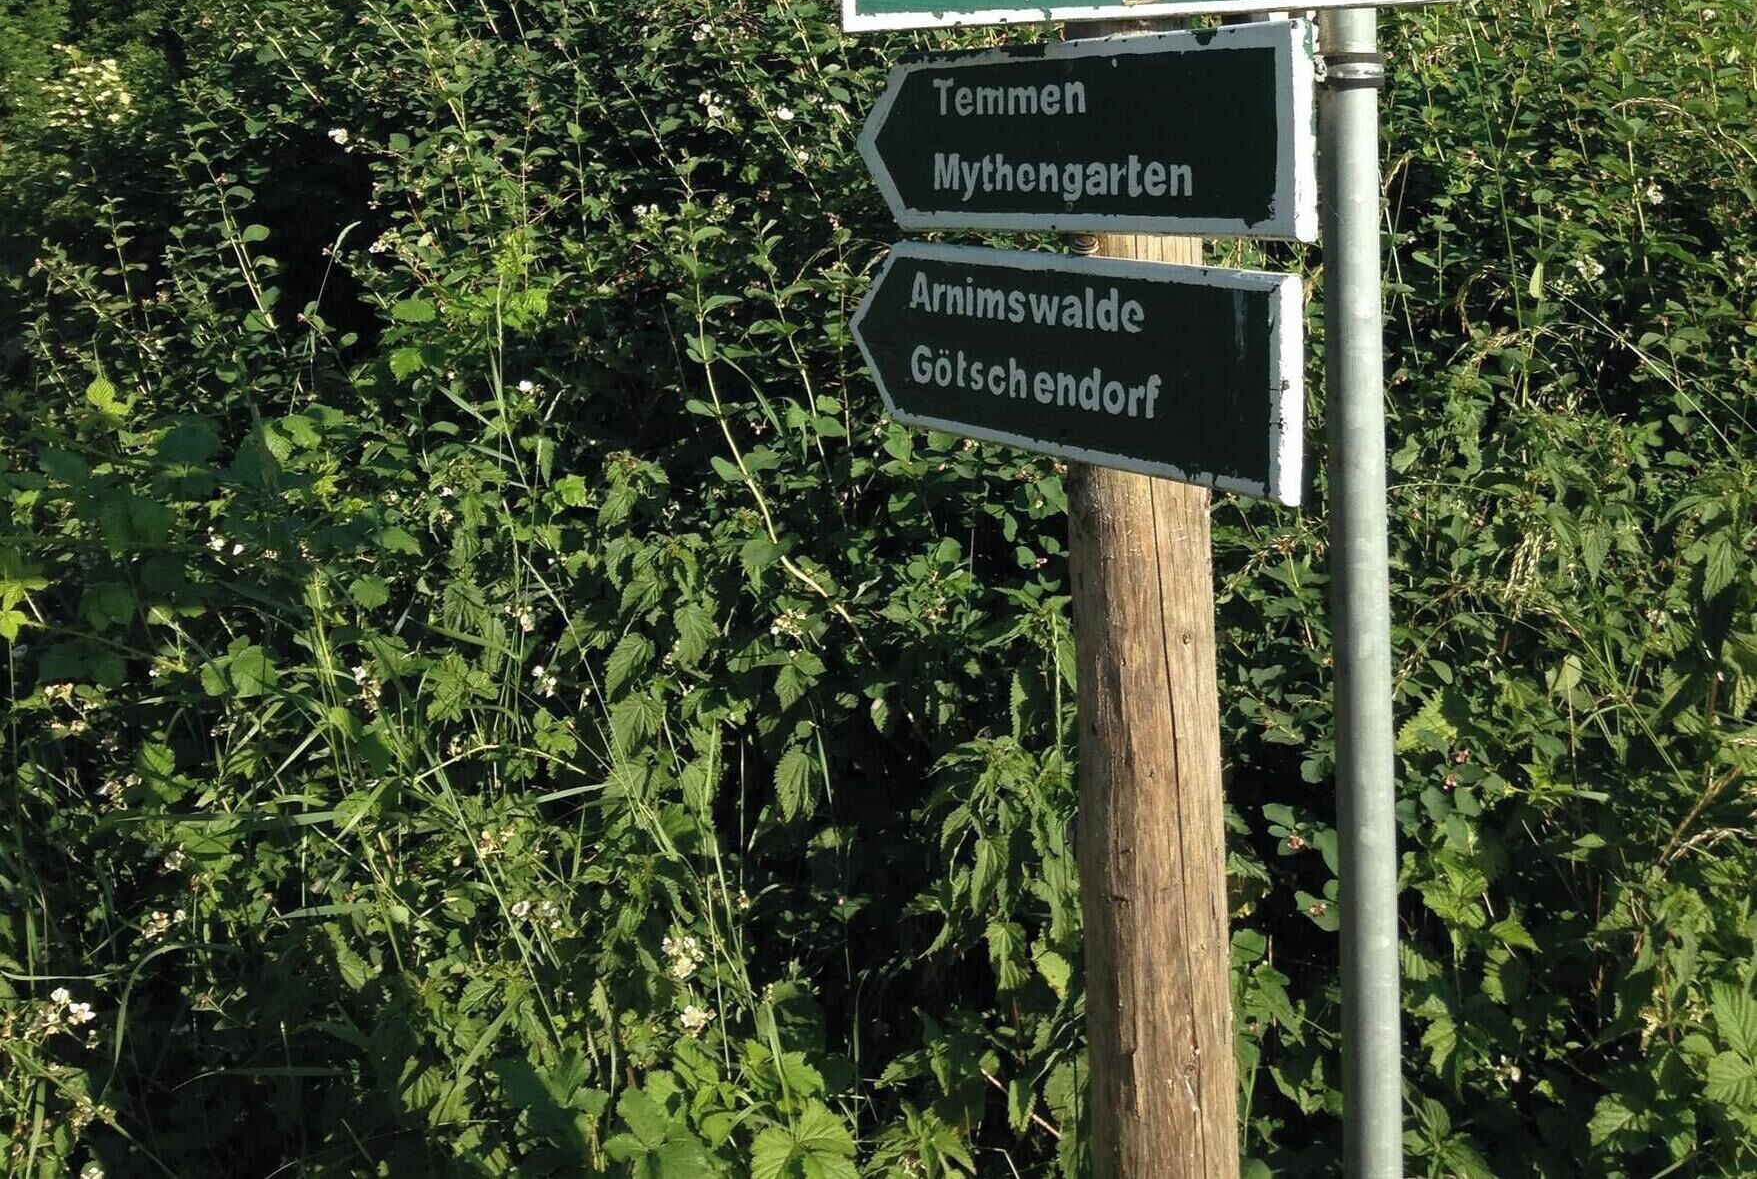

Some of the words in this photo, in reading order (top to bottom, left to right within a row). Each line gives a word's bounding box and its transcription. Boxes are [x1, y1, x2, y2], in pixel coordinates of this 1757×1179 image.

[932, 78, 1086, 116] Temmen
[934, 152, 1193, 202] Mythengarten
[909, 271, 1145, 334] Arnimswalde
[910, 344, 1162, 420] Götschendorf
